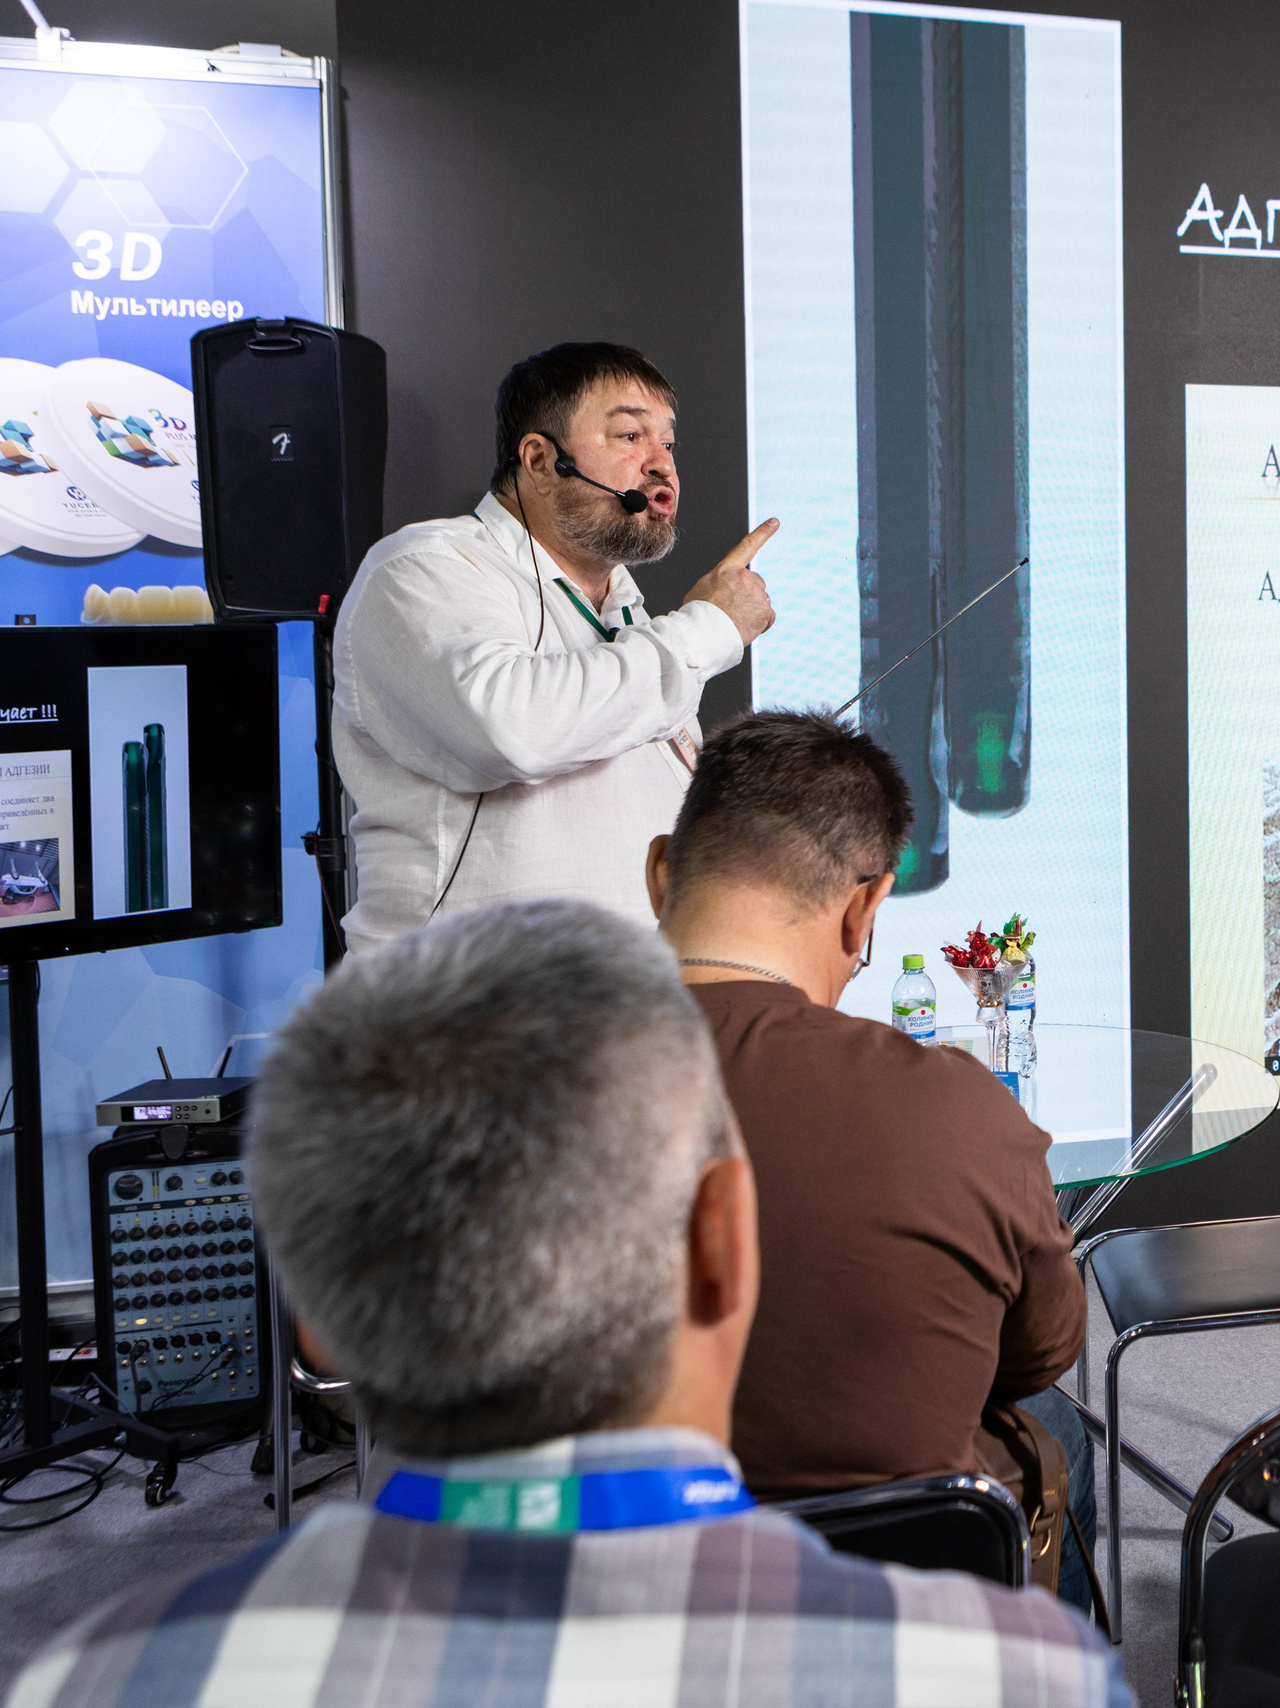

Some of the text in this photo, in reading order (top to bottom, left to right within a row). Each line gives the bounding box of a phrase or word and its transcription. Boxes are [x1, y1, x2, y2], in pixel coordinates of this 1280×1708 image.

[72, 229, 163, 281] 3D
[70, 289, 244, 322] Мультилеер
[147, 408, 187, 431] 3D
[164, 431, 188, 441] PLUS
[5, 764, 50, 777] АДГЕЗИИ
